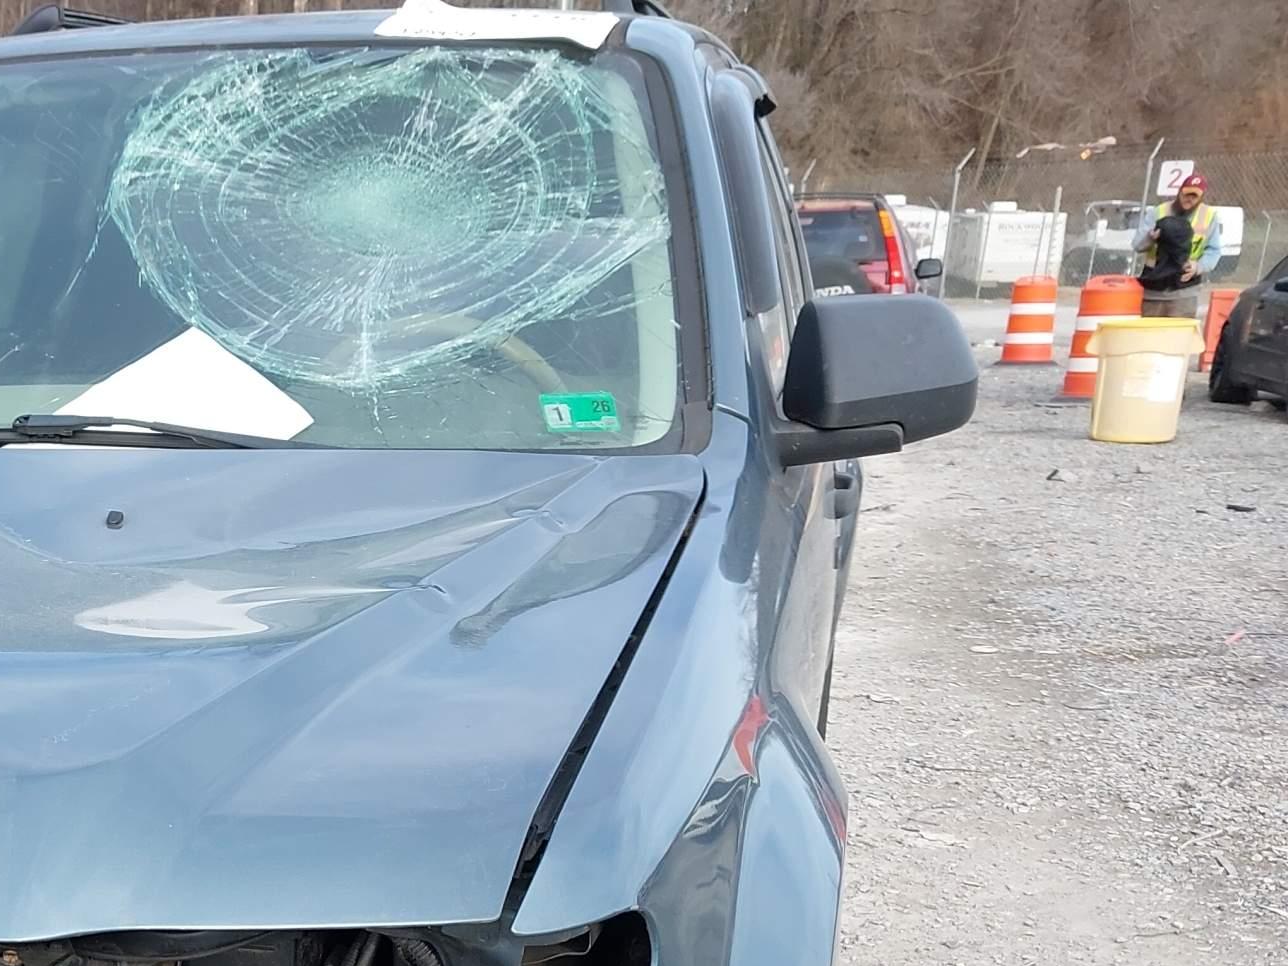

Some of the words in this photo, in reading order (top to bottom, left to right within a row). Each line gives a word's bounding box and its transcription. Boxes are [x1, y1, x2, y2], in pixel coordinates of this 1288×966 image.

[1167, 168, 1183, 188] 2
[552, 406, 564, 422] 1
[592, 400, 611, 413] 26
